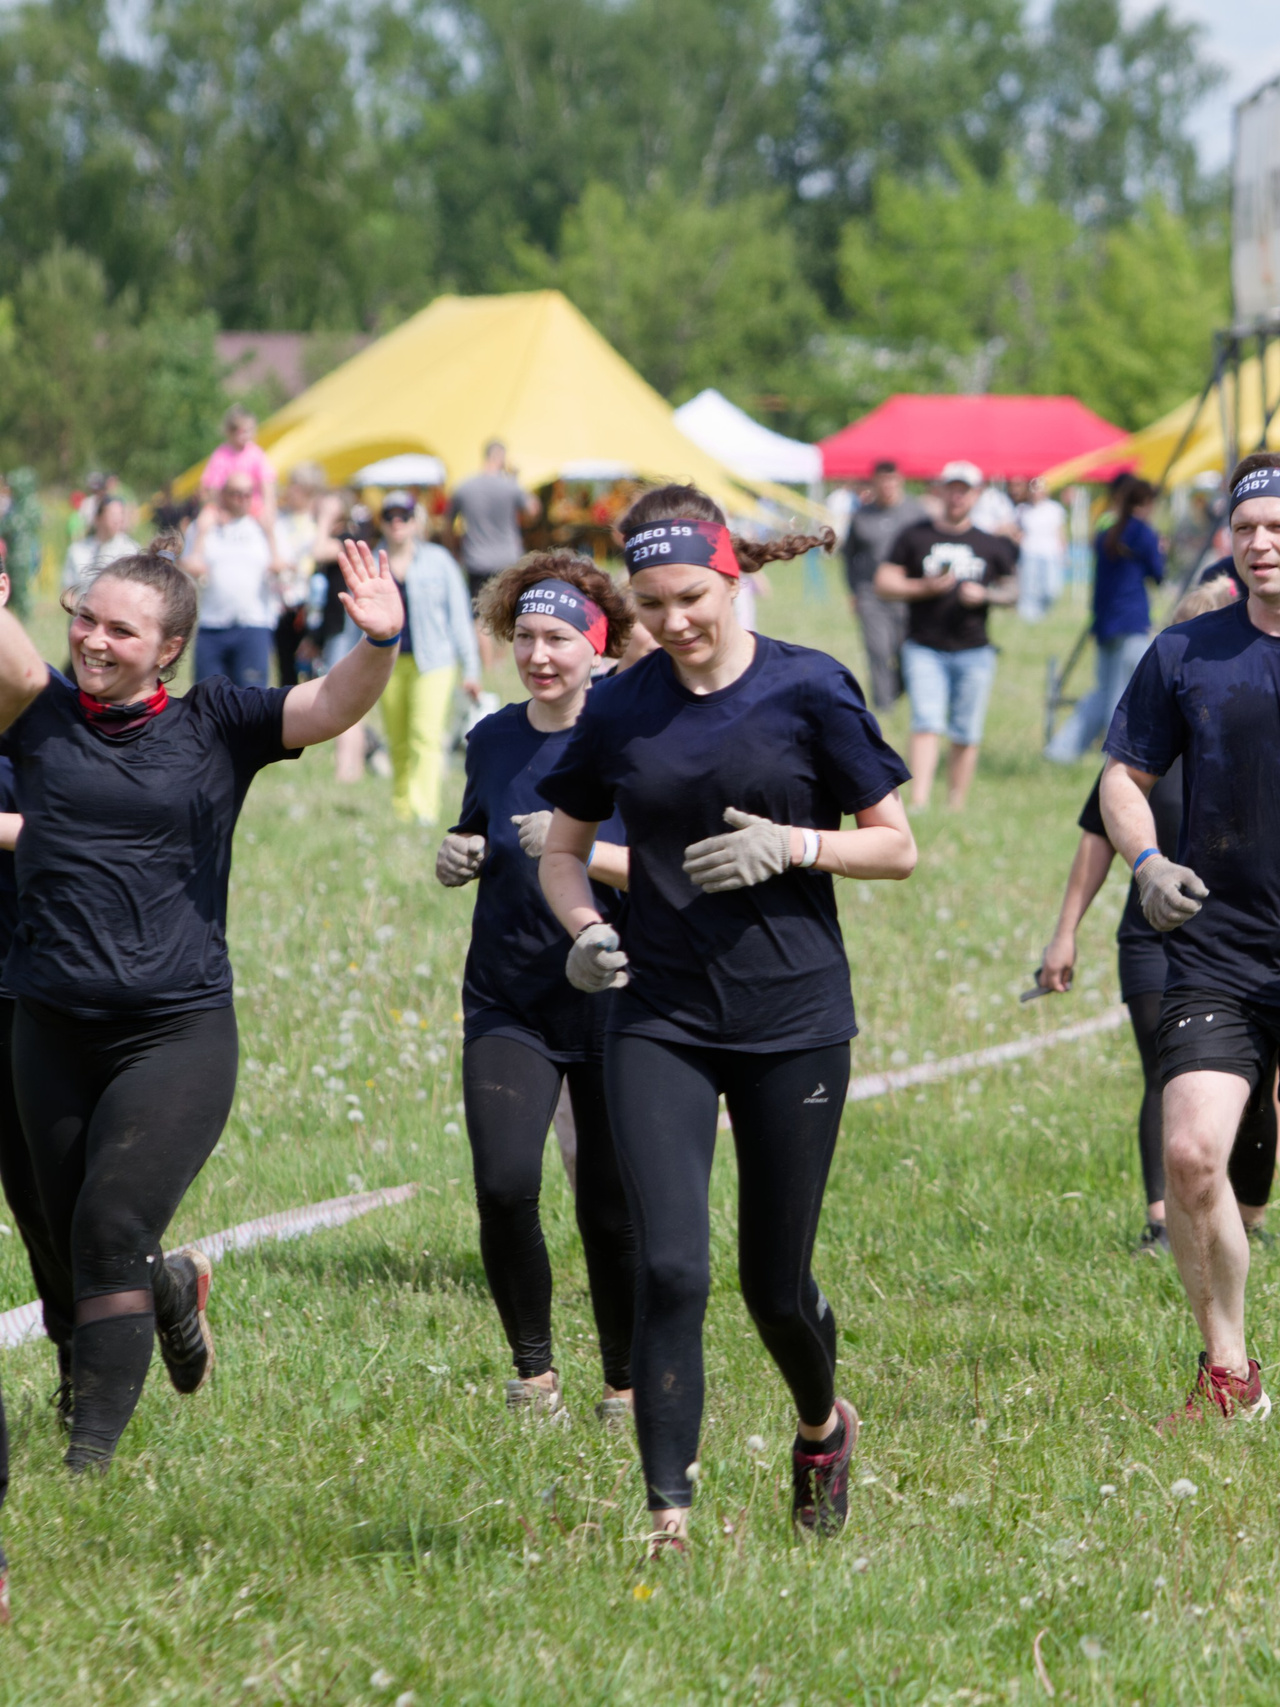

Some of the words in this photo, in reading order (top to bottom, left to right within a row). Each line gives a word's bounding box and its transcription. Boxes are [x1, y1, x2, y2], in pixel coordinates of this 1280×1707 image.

[1236, 479, 1270, 498] 2387
[670, 526, 693, 537] 59
[633, 541, 672, 562] 2378
[519, 589, 556, 601] ОДЕО
[558, 593, 577, 609] 59
[521, 602, 556, 615] 2380
